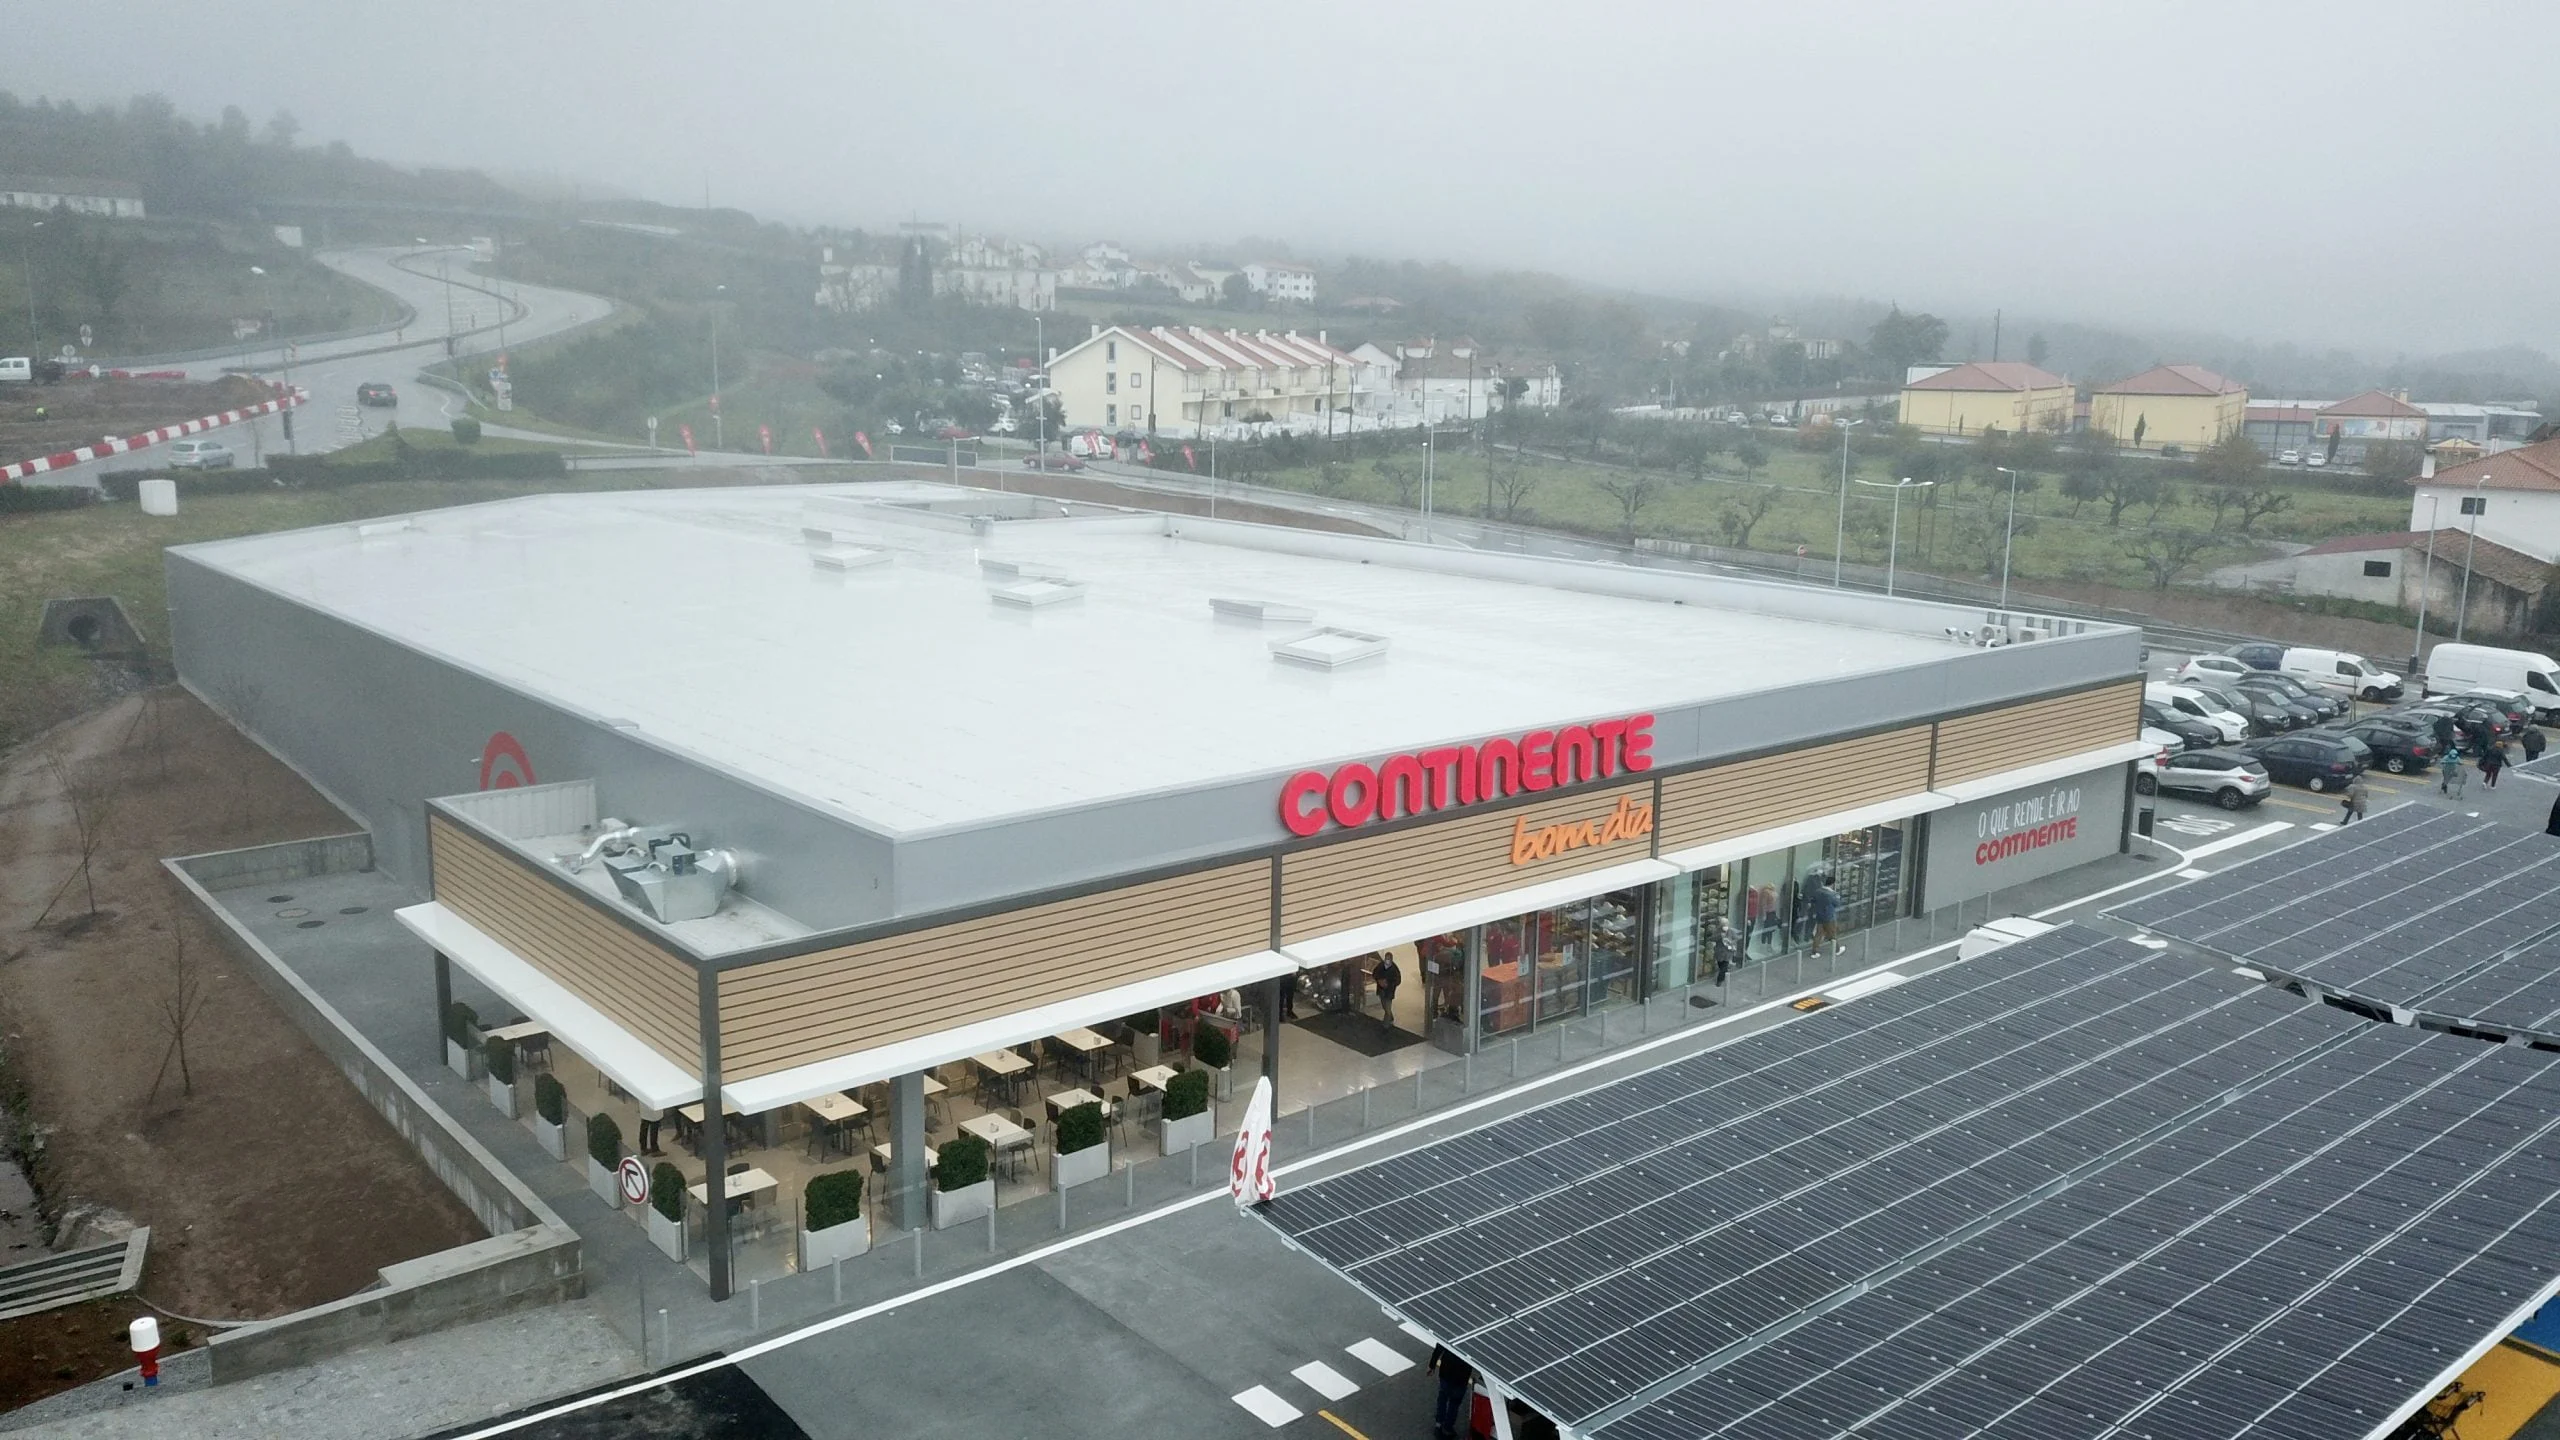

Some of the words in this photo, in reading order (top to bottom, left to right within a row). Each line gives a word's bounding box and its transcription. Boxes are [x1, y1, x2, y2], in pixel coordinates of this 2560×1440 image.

[1279, 713, 1656, 837] CONTINENTE
[1510, 815, 1601, 866] bom
[1600, 794, 1655, 846] dia
[1975, 816, 2077, 865] CONTINENTE
[1978, 812, 1987, 838] O
[1990, 806, 2010, 836] QUE
[2014, 796, 2045, 828] RENDE
[2057, 791, 2066, 816] IR
[2066, 788, 2080, 814] AO
